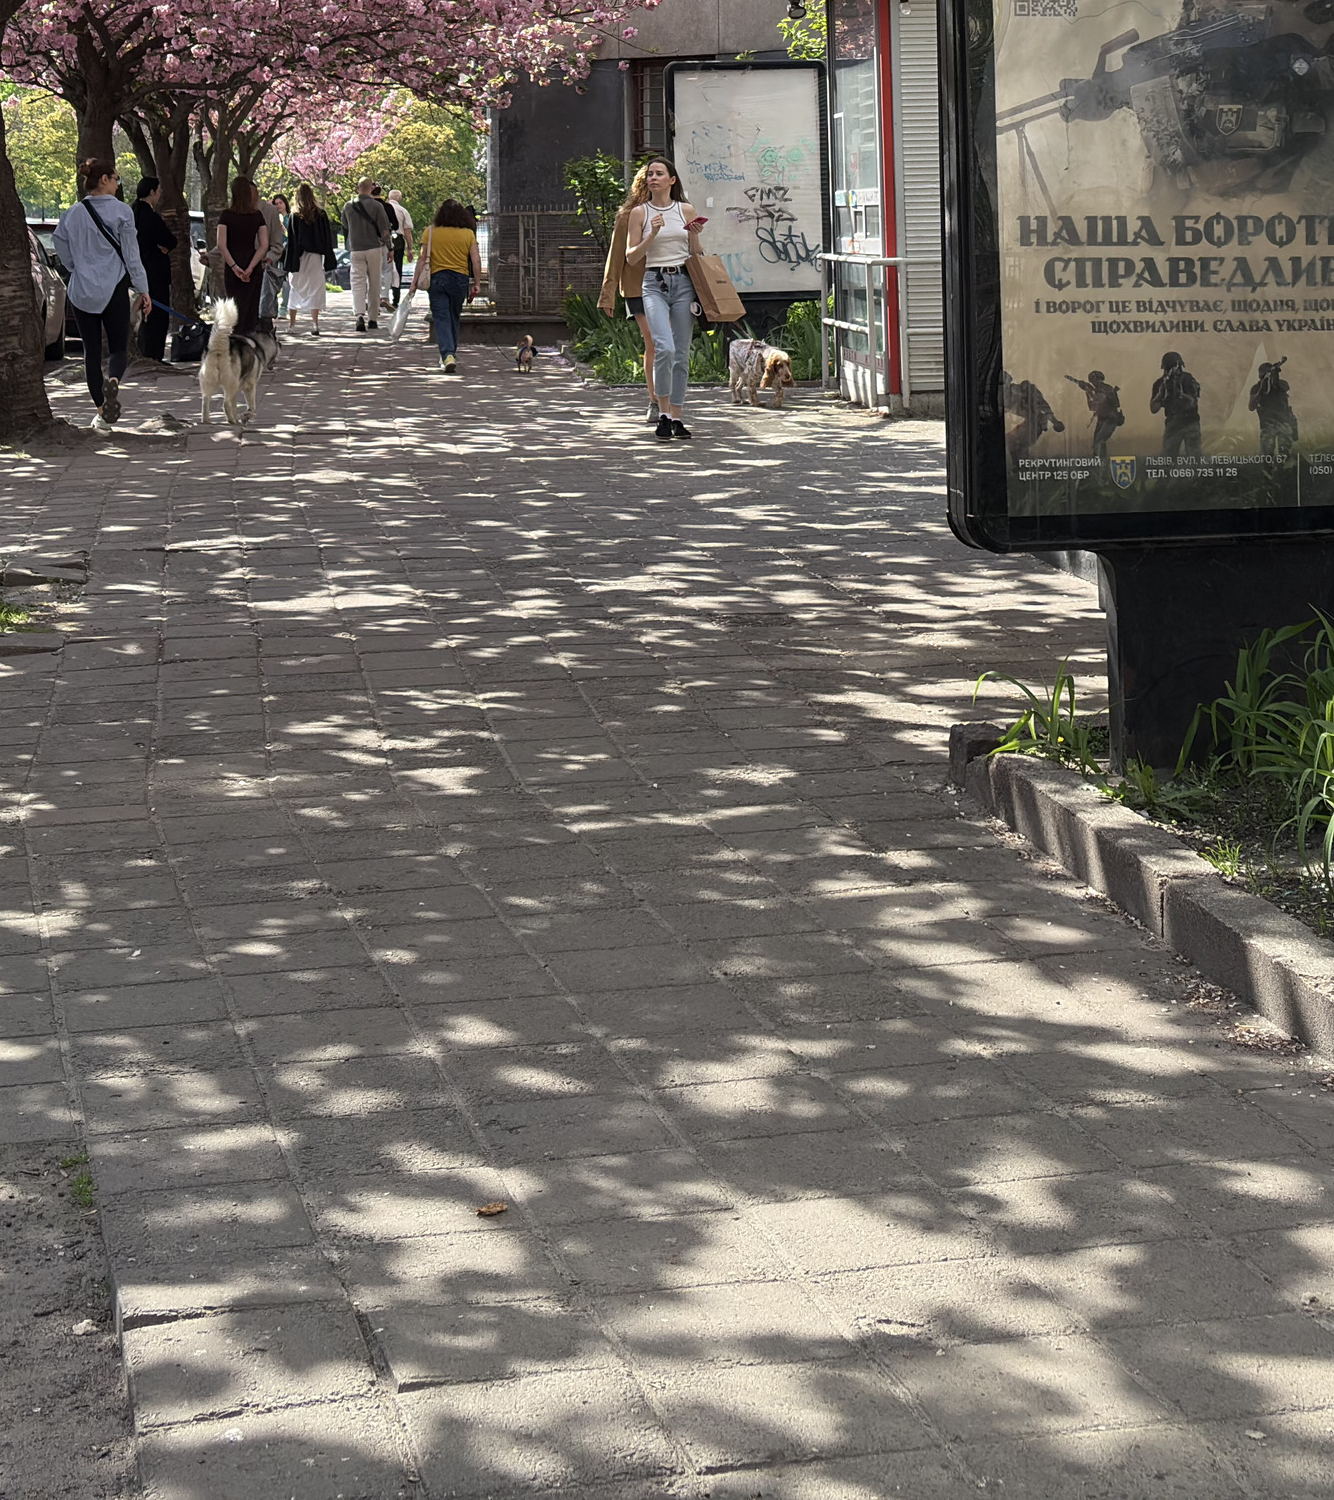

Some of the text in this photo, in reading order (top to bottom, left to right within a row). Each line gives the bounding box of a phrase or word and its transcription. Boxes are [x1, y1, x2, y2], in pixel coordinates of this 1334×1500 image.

[1017, 215, 1166, 247] НАША
[1045, 300, 1106, 314] ВОРОГ
[1108, 300, 1133, 316] ЦЕ
[1135, 298, 1228, 314] ВІДЧУВАЄ,
[1231, 299, 1300, 314] ЩОДНЯ,
[1212, 319, 1273, 333] СЛАВА
[1018, 456, 1102, 468] РЕКРУТИНГОВИЙ
[1176, 456, 1199, 466] ВУЛ.
[1200, 456, 1210, 465] К.
[1211, 455, 1275, 466] ЛЕВИЦЬКОГО,
[1276, 454, 1288, 464] 67
[1019, 470, 1090, 481] ЦЕНТР 125 ОБР
[1146, 468, 1238, 479] ТЕЛ. (066) 735 11 26
[1309, 466, 1333, 475] (050)
